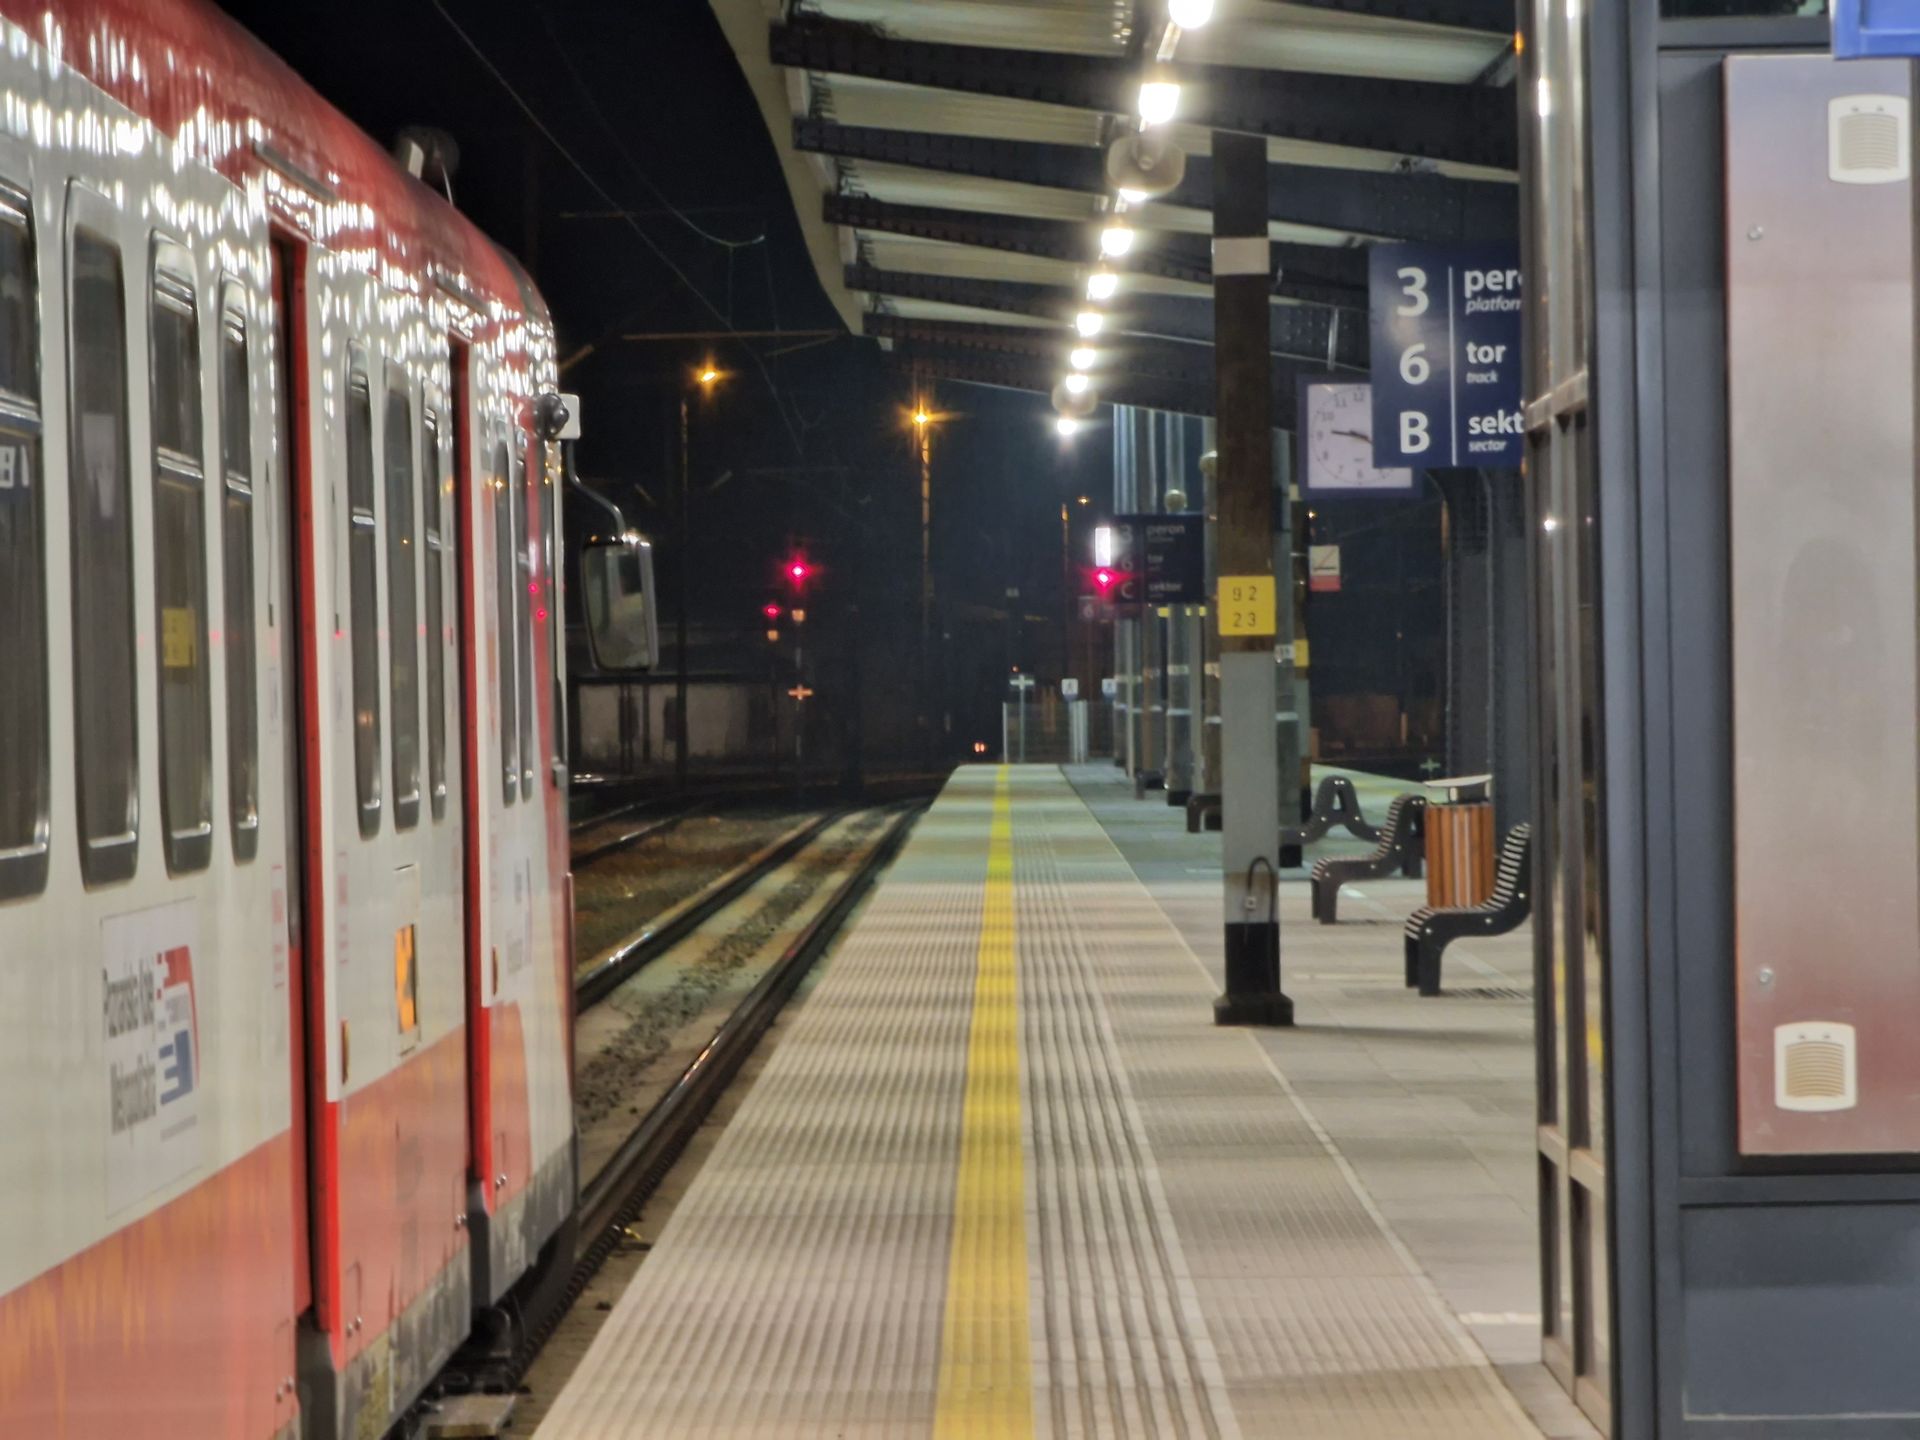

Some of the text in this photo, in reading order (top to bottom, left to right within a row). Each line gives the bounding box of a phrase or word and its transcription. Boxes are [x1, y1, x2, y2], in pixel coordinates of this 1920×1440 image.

[1397, 266, 1429, 317] 3
[1464, 268, 1523, 298] per
[1399, 343, 1430, 385] 6
[1466, 341, 1507, 364] tor
[1399, 410, 1431, 454] B
